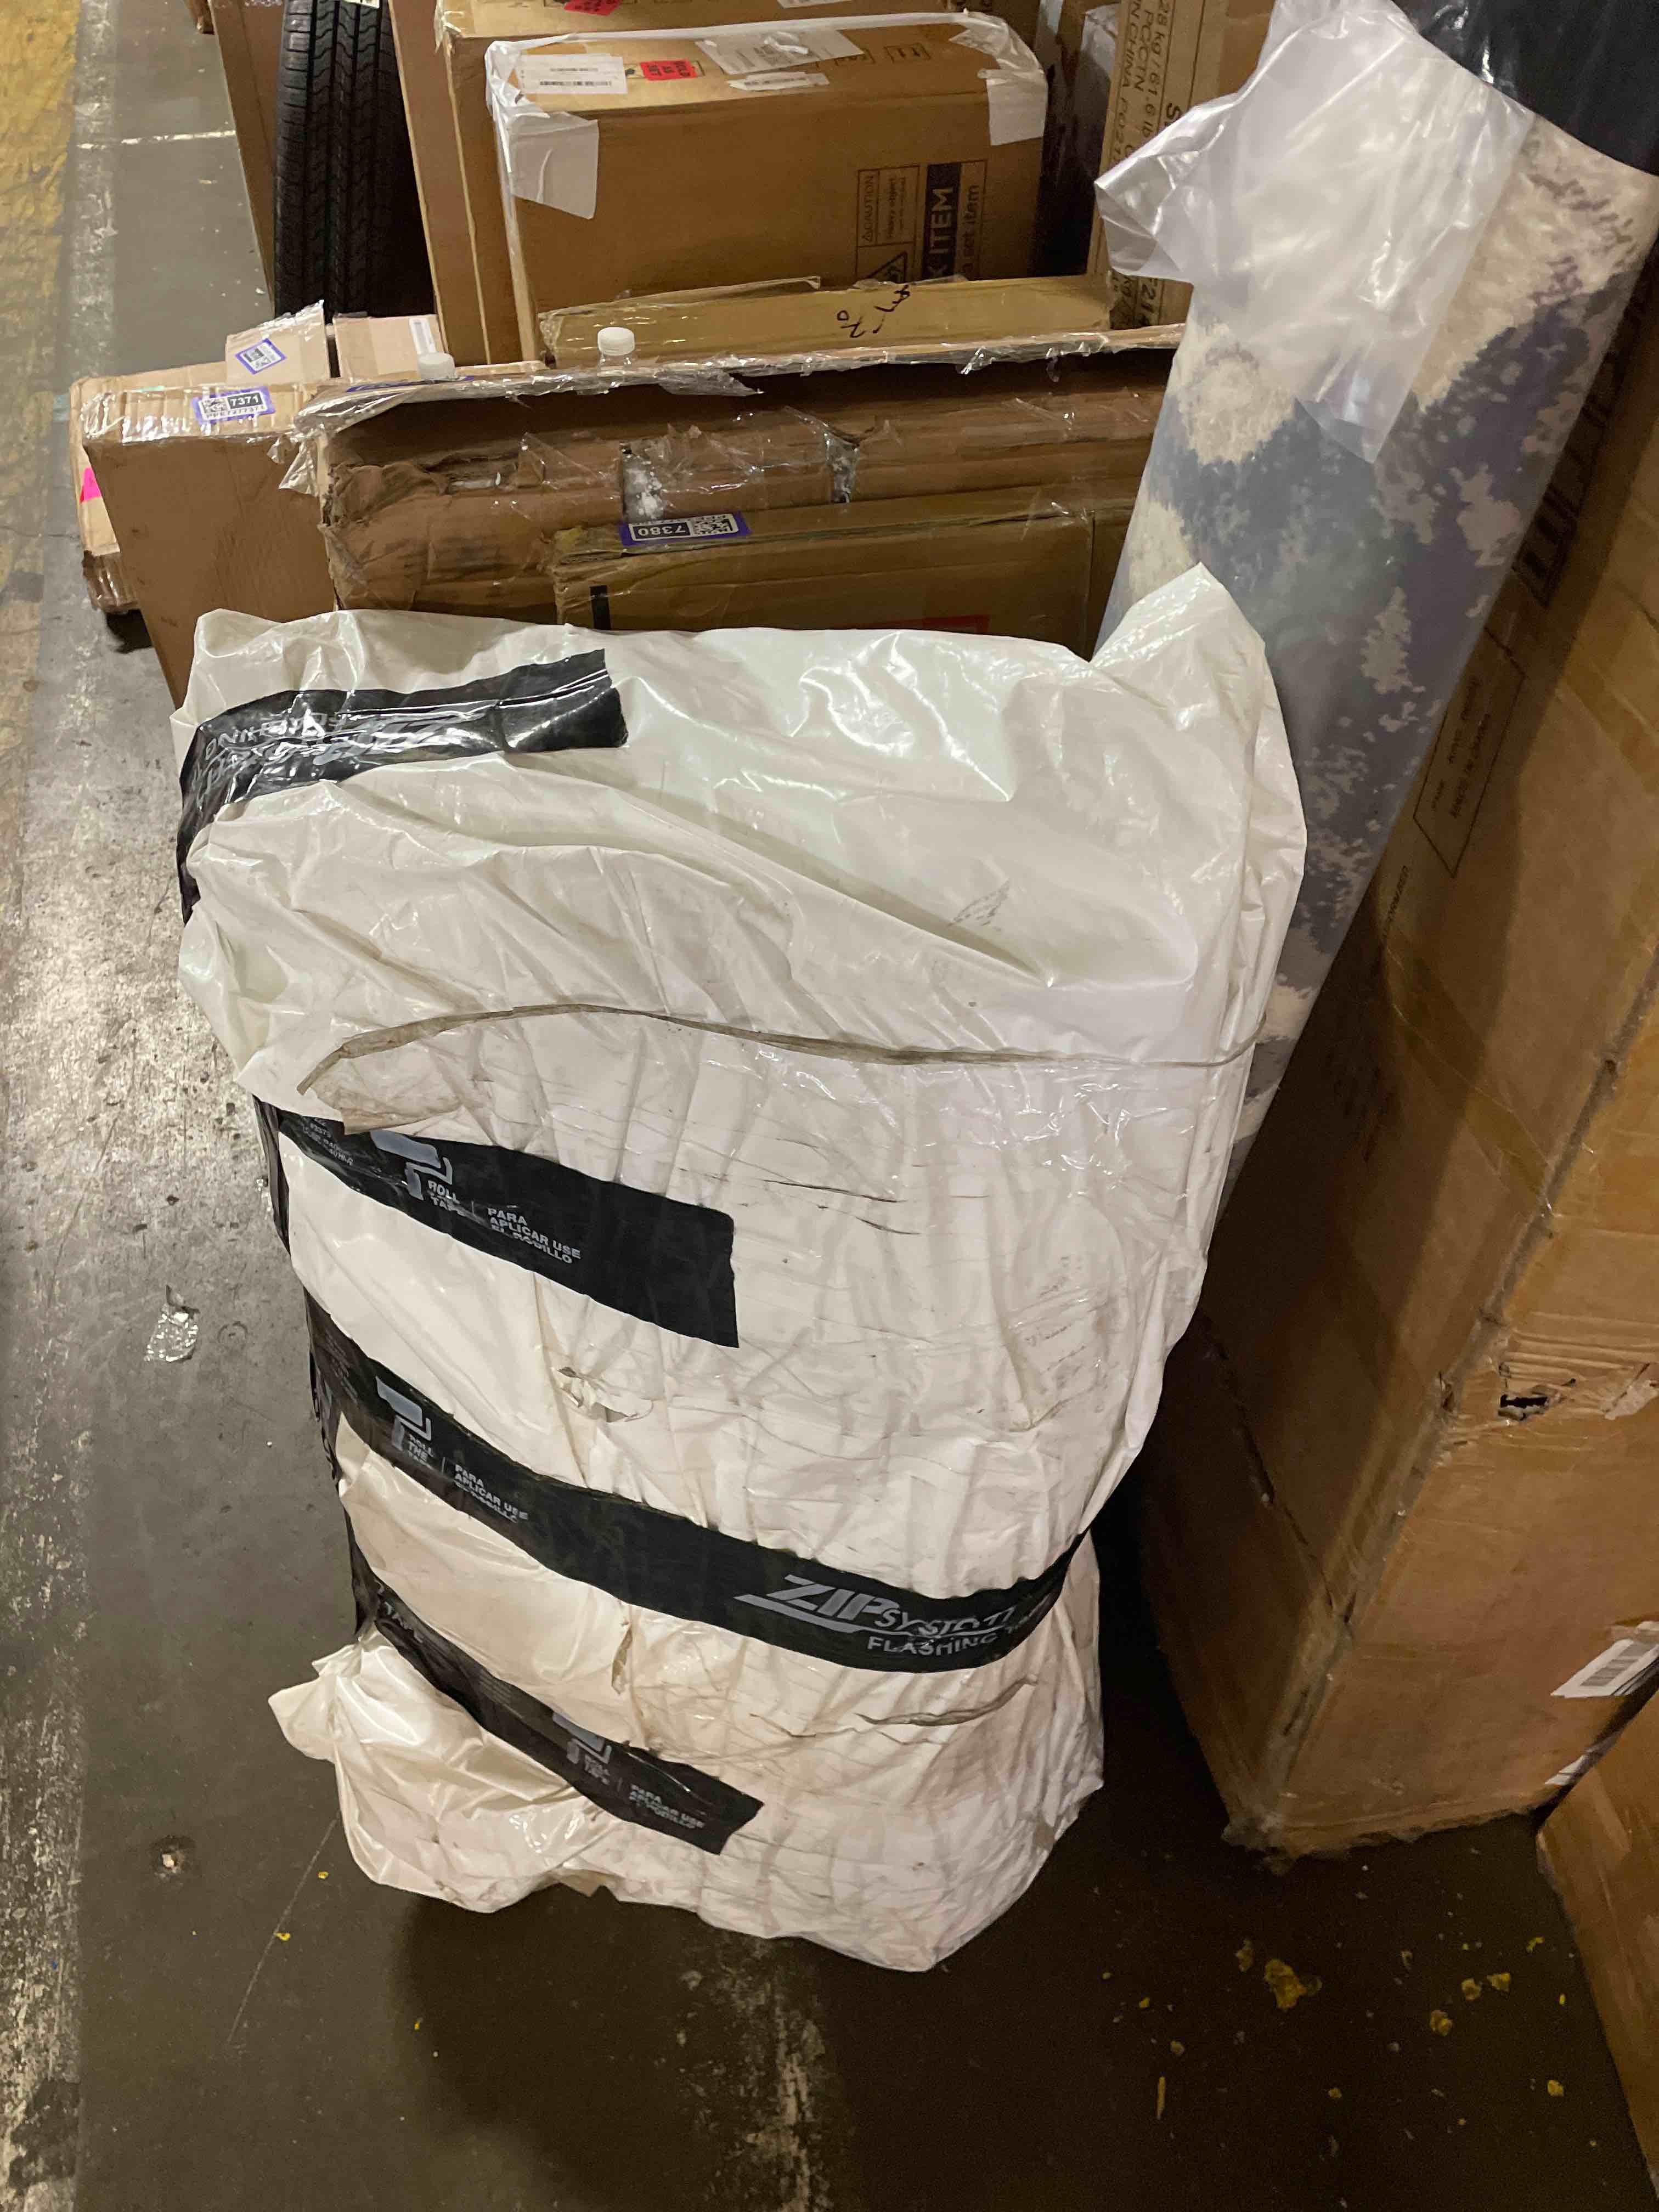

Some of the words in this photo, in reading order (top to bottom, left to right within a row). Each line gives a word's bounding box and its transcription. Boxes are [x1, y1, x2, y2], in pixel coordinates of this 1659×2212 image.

[929, 187, 954, 255] ITEM
[230, 394, 259, 407] 7371
[637, 524, 686, 537] 7380
[428, 1180, 460, 1204] ROLL
[488, 1207, 527, 1226] PARA
[490, 1217, 549, 1246] APLICAR
[552, 1239, 582, 1260] USE
[408, 1441, 428, 1462] THE
[455, 1464, 484, 1487] PARA
[455, 1473, 501, 1506] APLICAR
[504, 1502, 528, 1520] USE
[766, 1574, 900, 1621] ZIP
[867, 1631, 997, 1656] FLASHING
